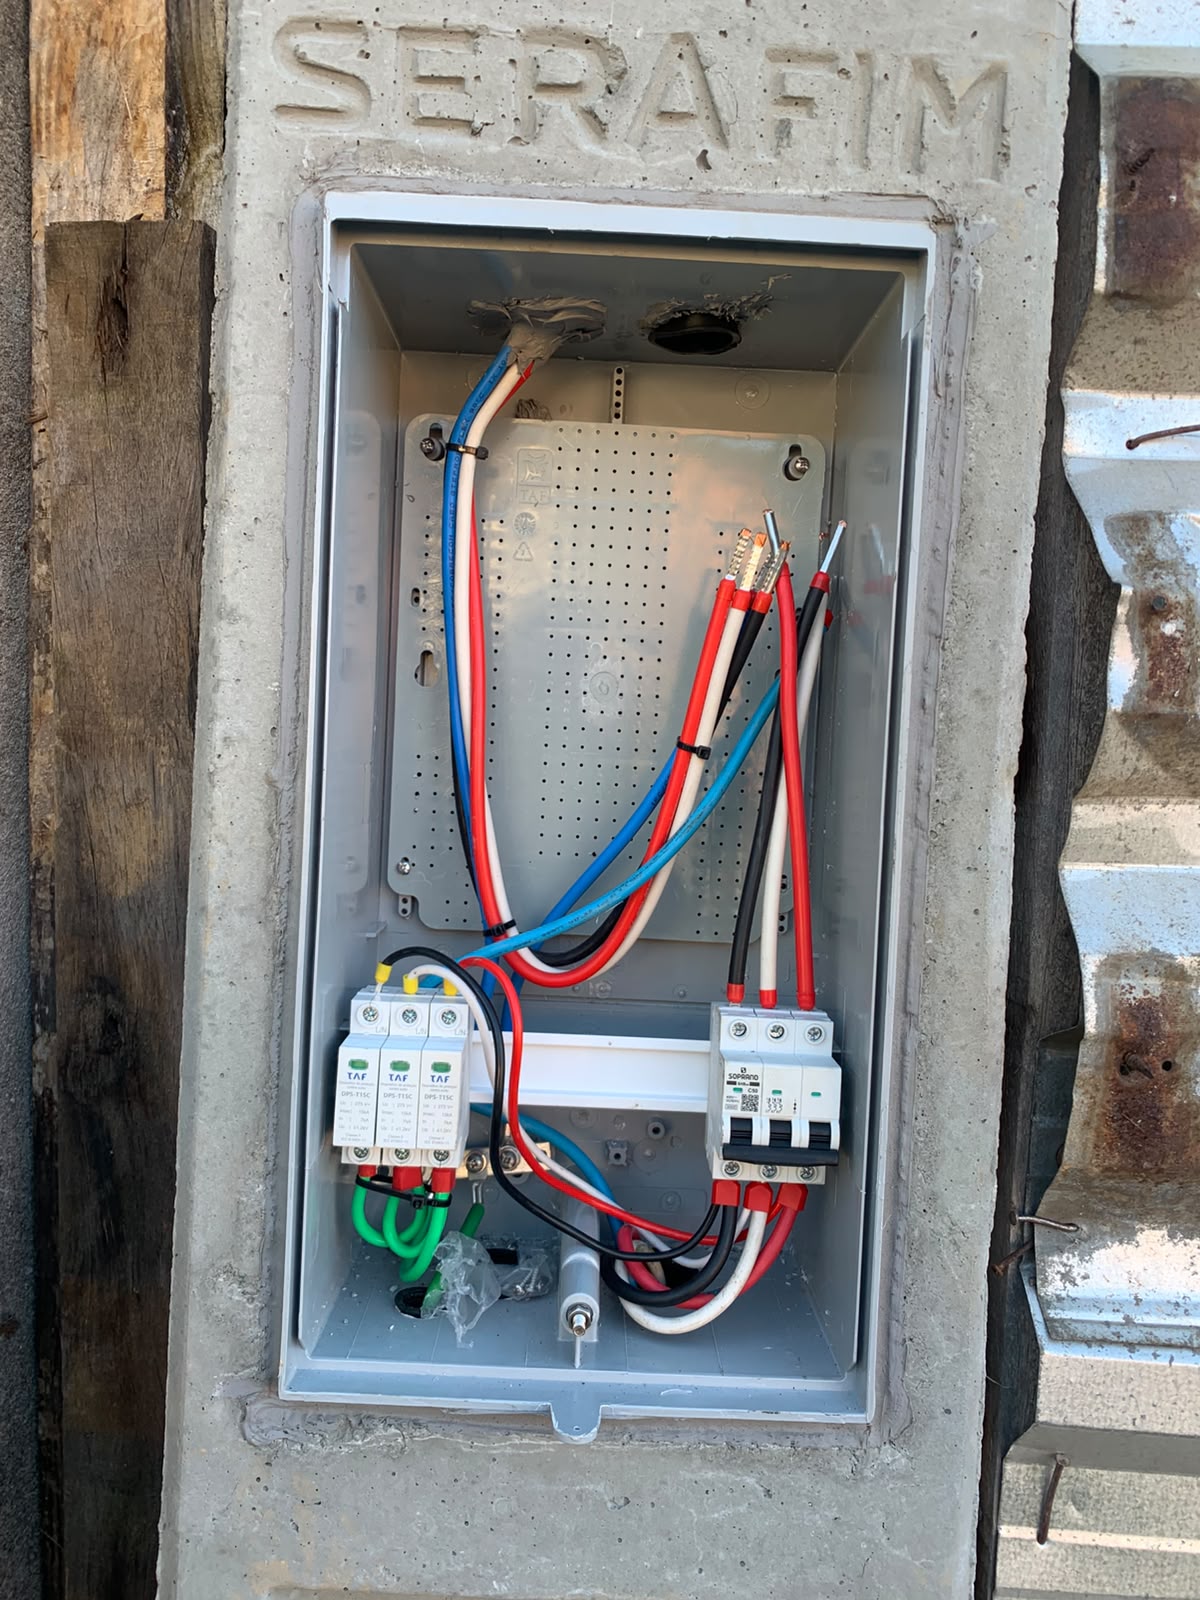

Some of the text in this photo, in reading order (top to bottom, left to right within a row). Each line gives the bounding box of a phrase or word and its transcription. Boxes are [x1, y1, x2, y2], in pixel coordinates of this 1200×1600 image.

[273, 15, 1010, 183] SERAFIM
[519, 488, 547, 503] TAF
[347, 1072, 367, 1081] TAF
[388, 1073, 409, 1082] TAF
[430, 1075, 450, 1083] TAF
